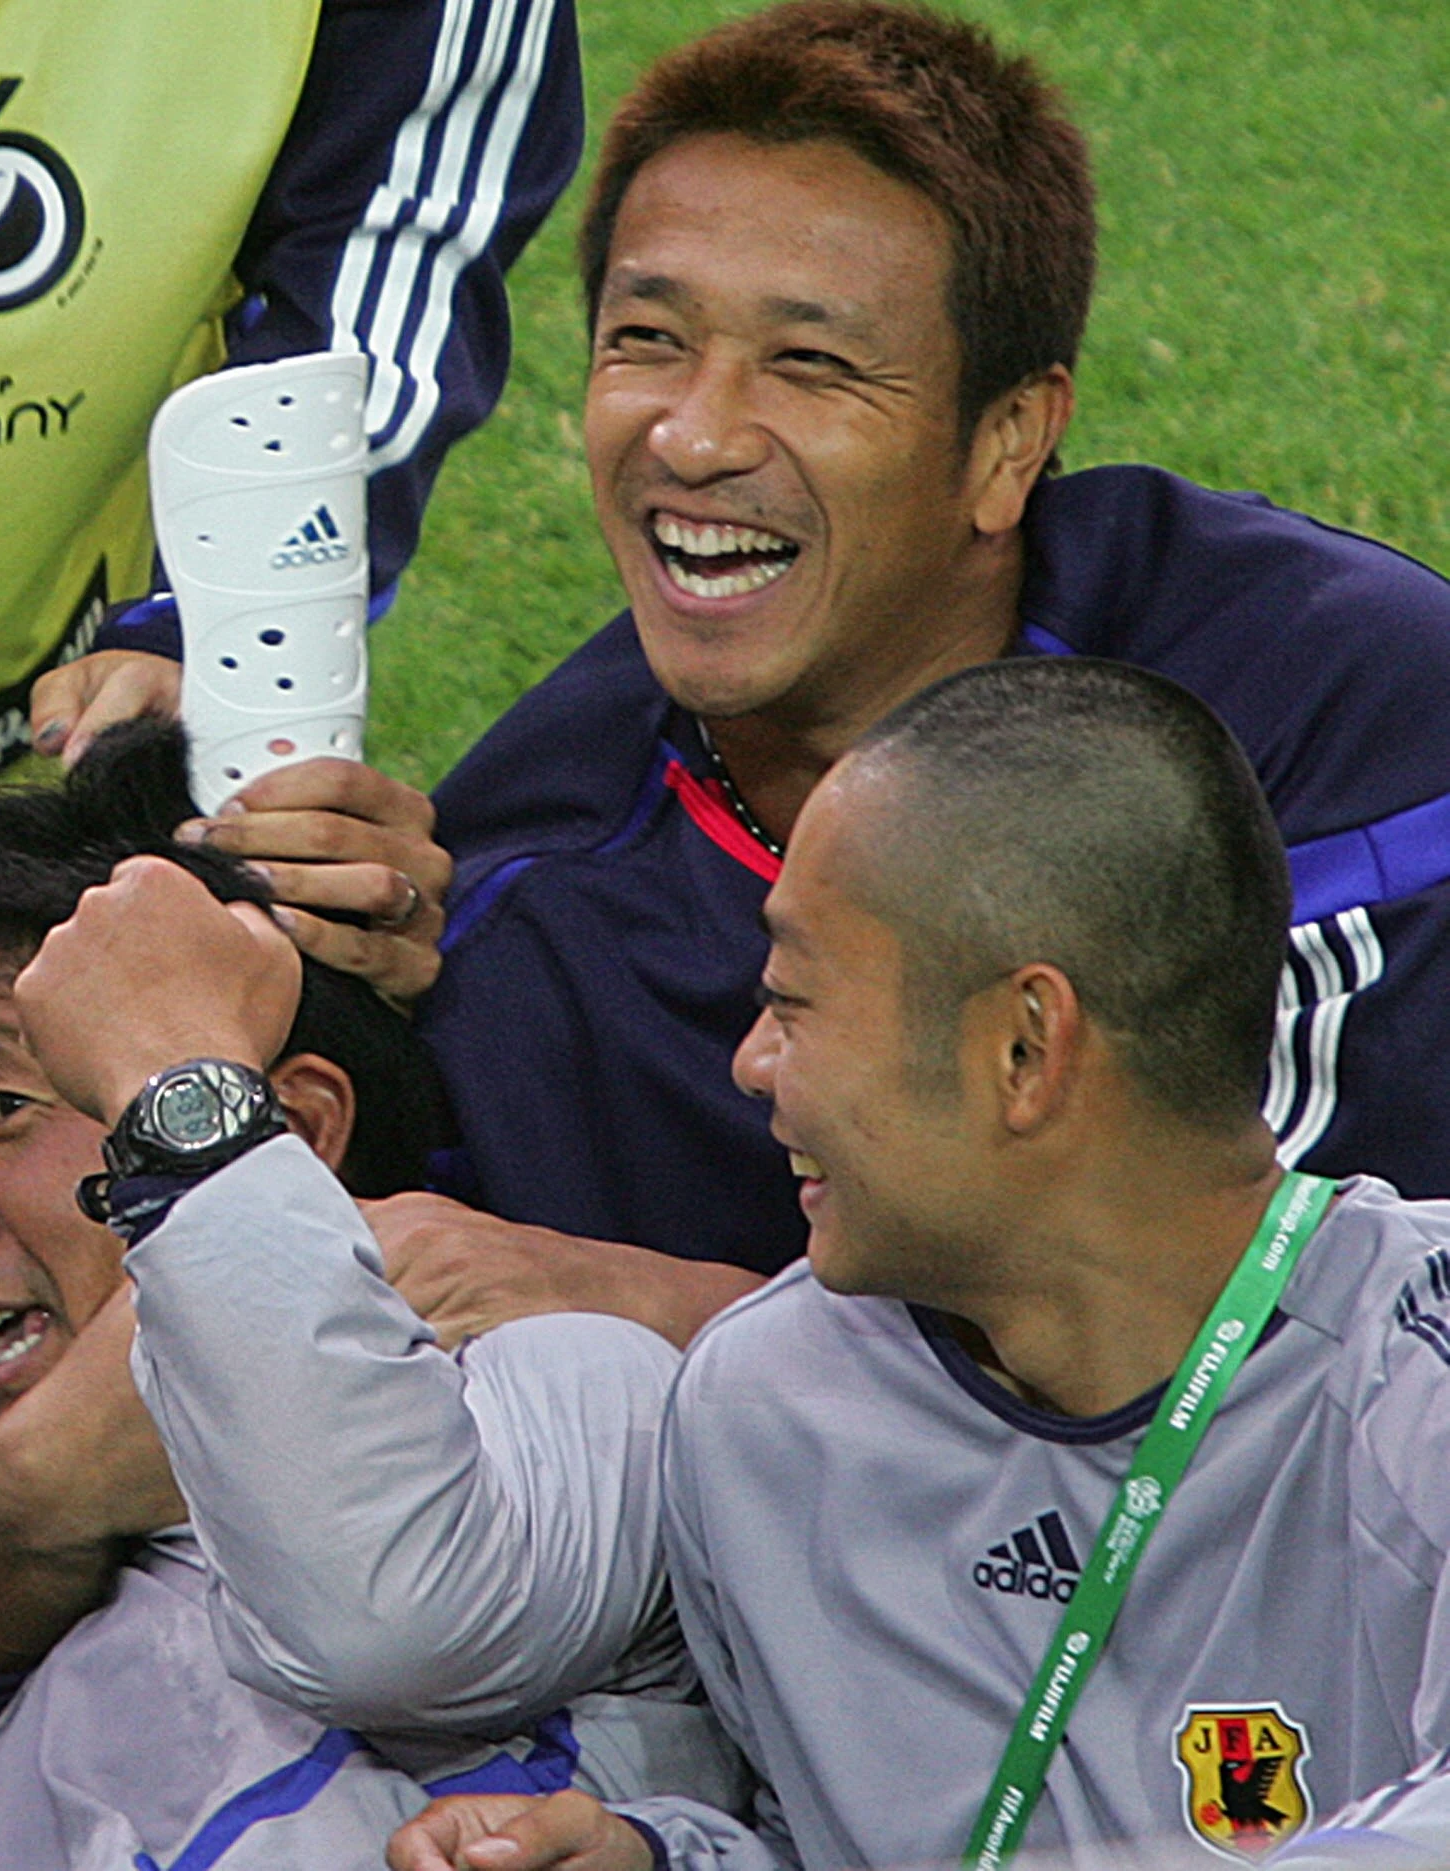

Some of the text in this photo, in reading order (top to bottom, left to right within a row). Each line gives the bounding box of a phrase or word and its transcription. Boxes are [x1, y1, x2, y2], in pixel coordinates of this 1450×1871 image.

[270, 544, 350, 570] adidas
[1169, 1342, 1228, 1430] FUJIFILM
[974, 1558, 1080, 1604] adida
[1029, 1652, 1078, 1742] FUJIFILM
[1193, 1726, 1282, 1753] JFA
